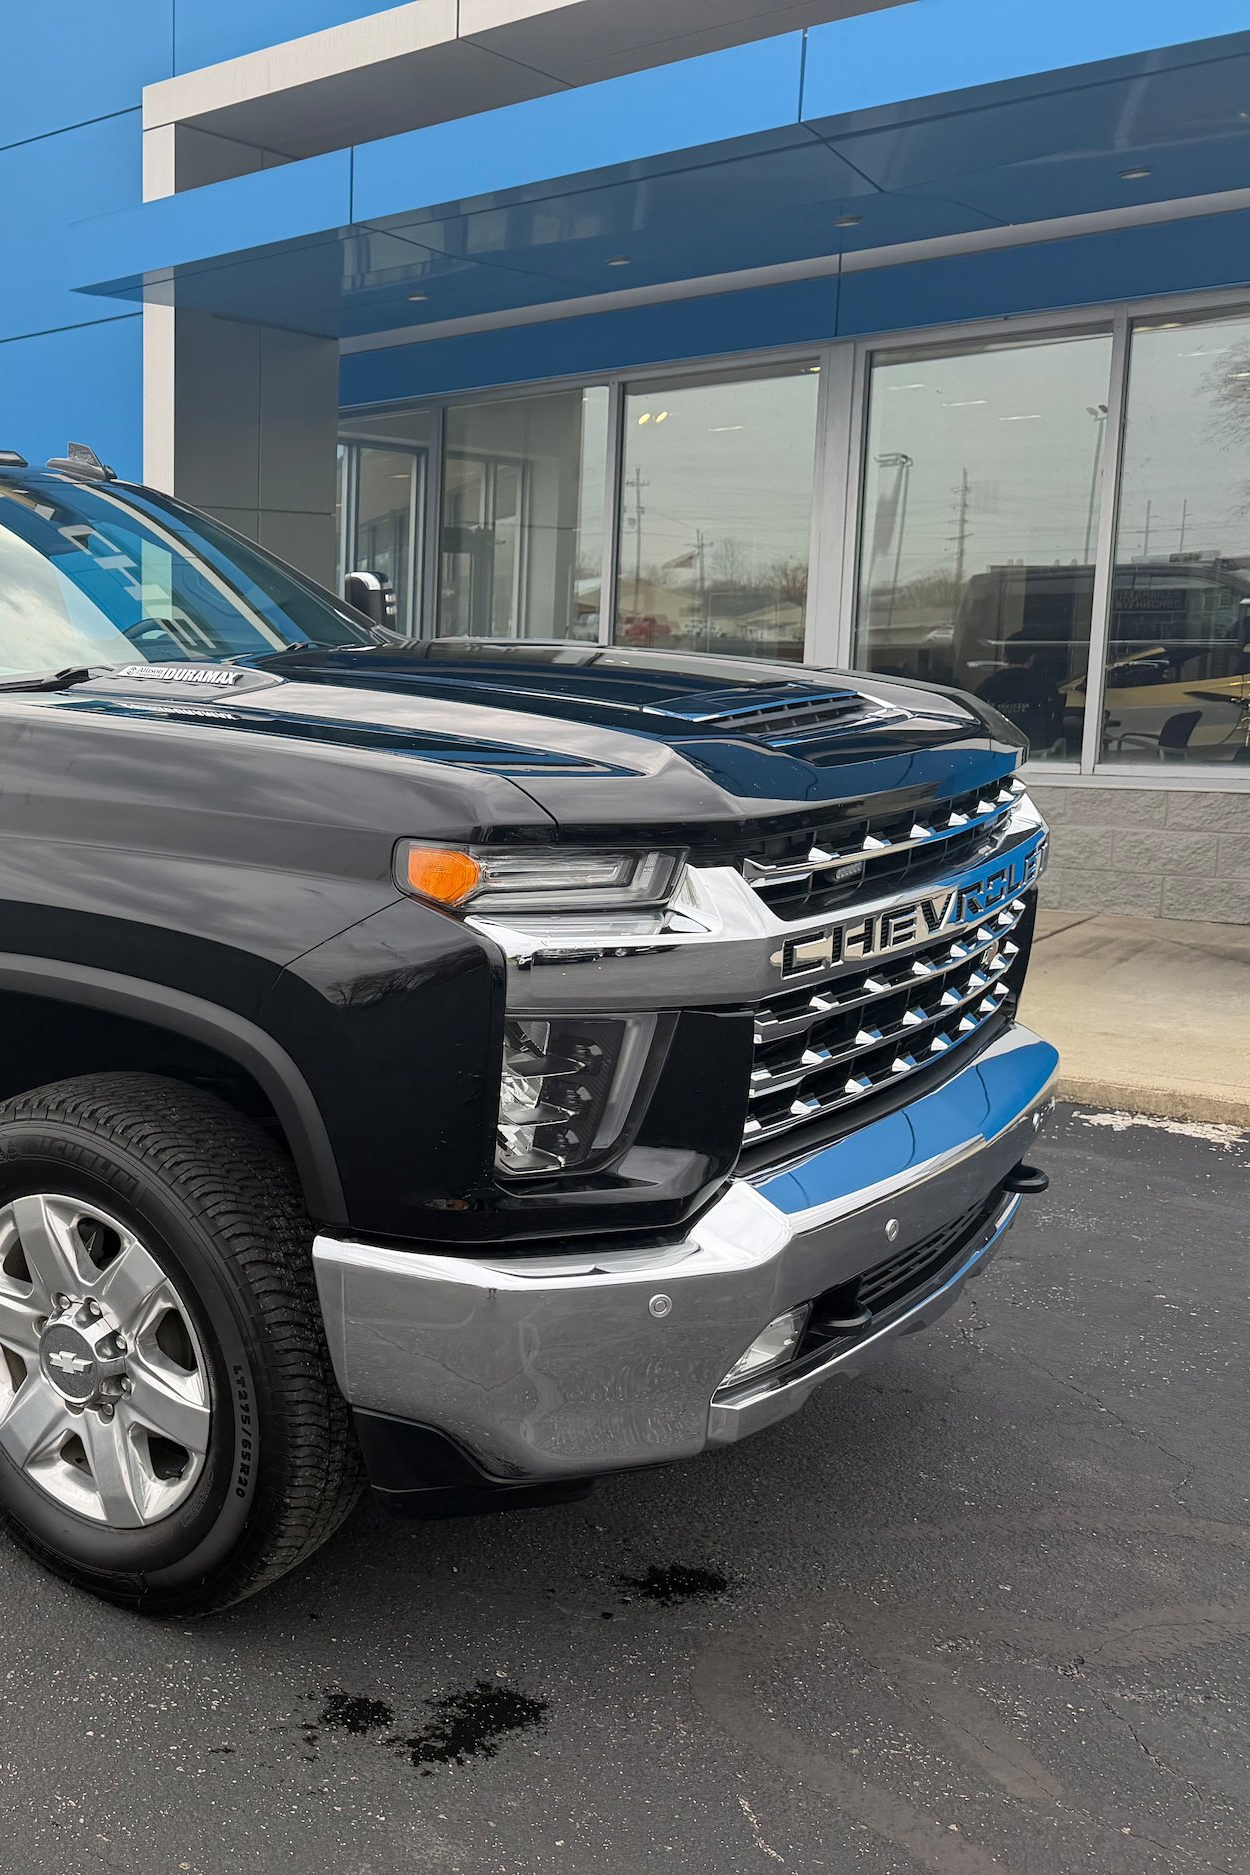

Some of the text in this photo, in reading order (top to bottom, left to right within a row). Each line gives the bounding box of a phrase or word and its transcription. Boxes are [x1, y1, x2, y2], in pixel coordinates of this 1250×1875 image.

[163, 667, 241, 686] DURAMAX
[780, 840, 1048, 981] CHEVROLET
[232, 1364, 253, 1499] LT275/65R20
